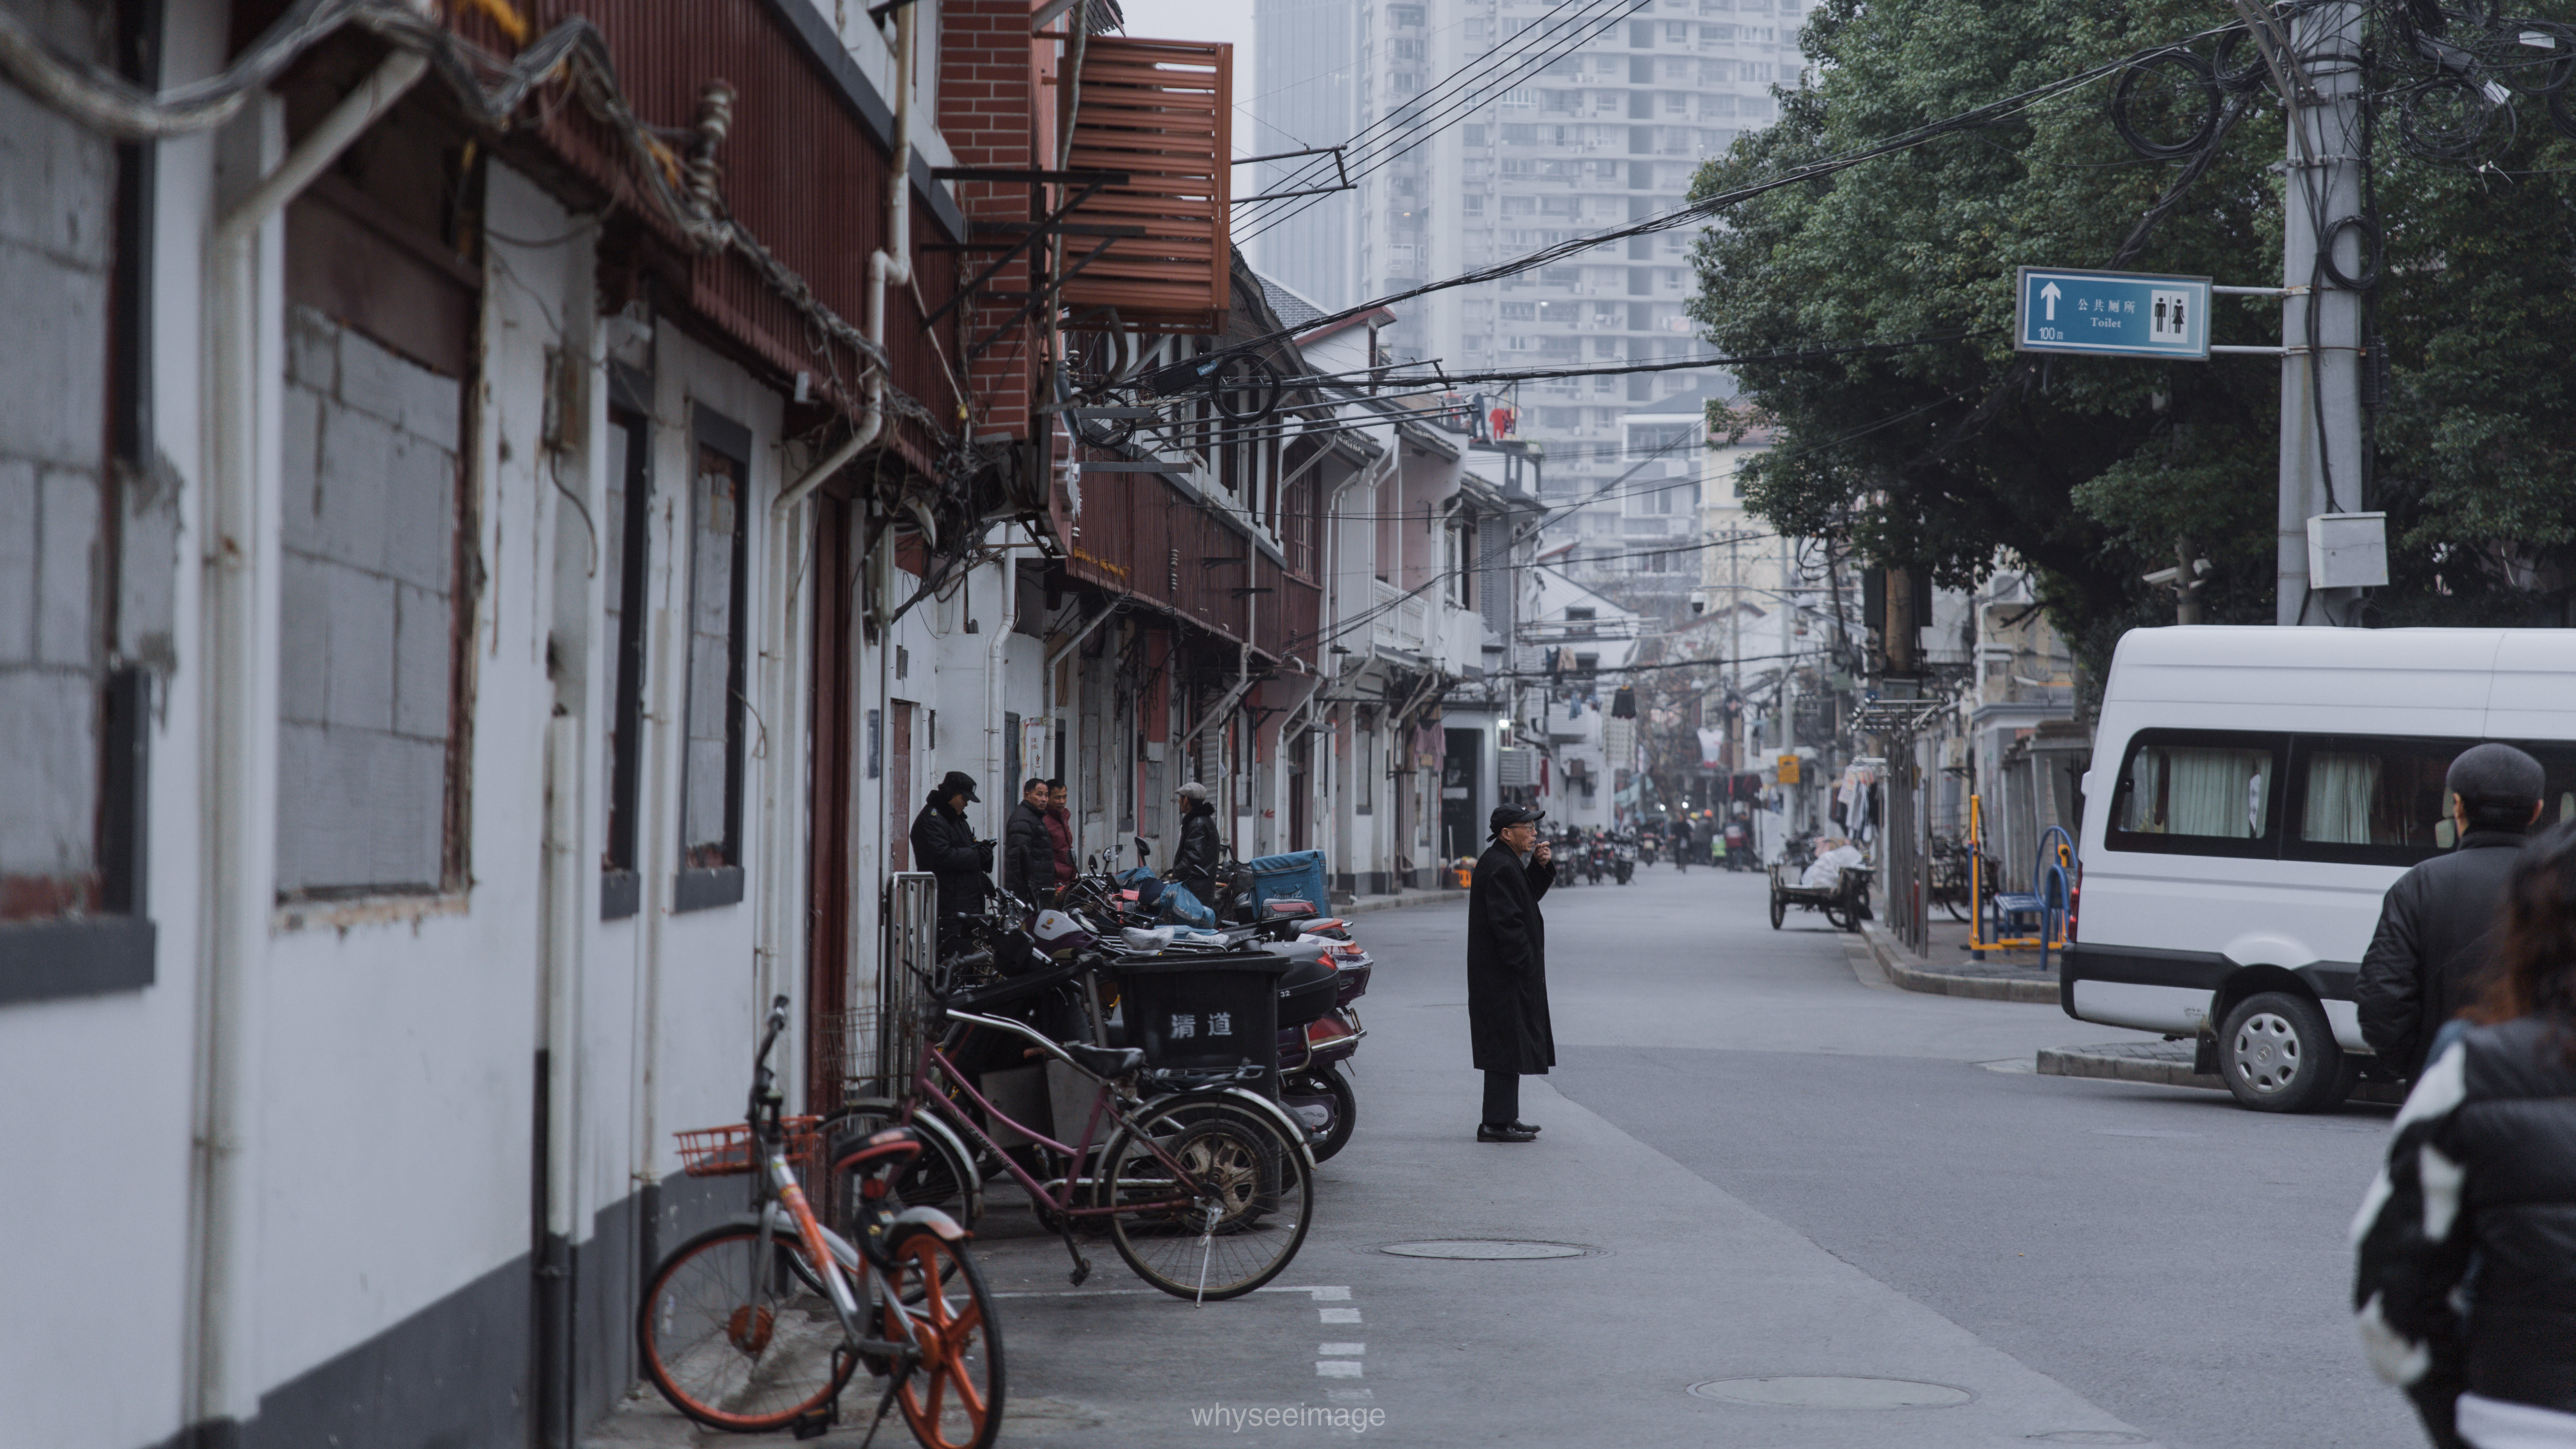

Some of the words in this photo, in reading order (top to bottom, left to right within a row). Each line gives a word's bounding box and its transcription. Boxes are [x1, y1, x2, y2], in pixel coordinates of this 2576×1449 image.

[2090, 317, 2122, 328] Toilet
[2039, 327, 2055, 339] 100
[2057, 331, 2063, 339] m
[1171, 1012, 1232, 1038] 清道
